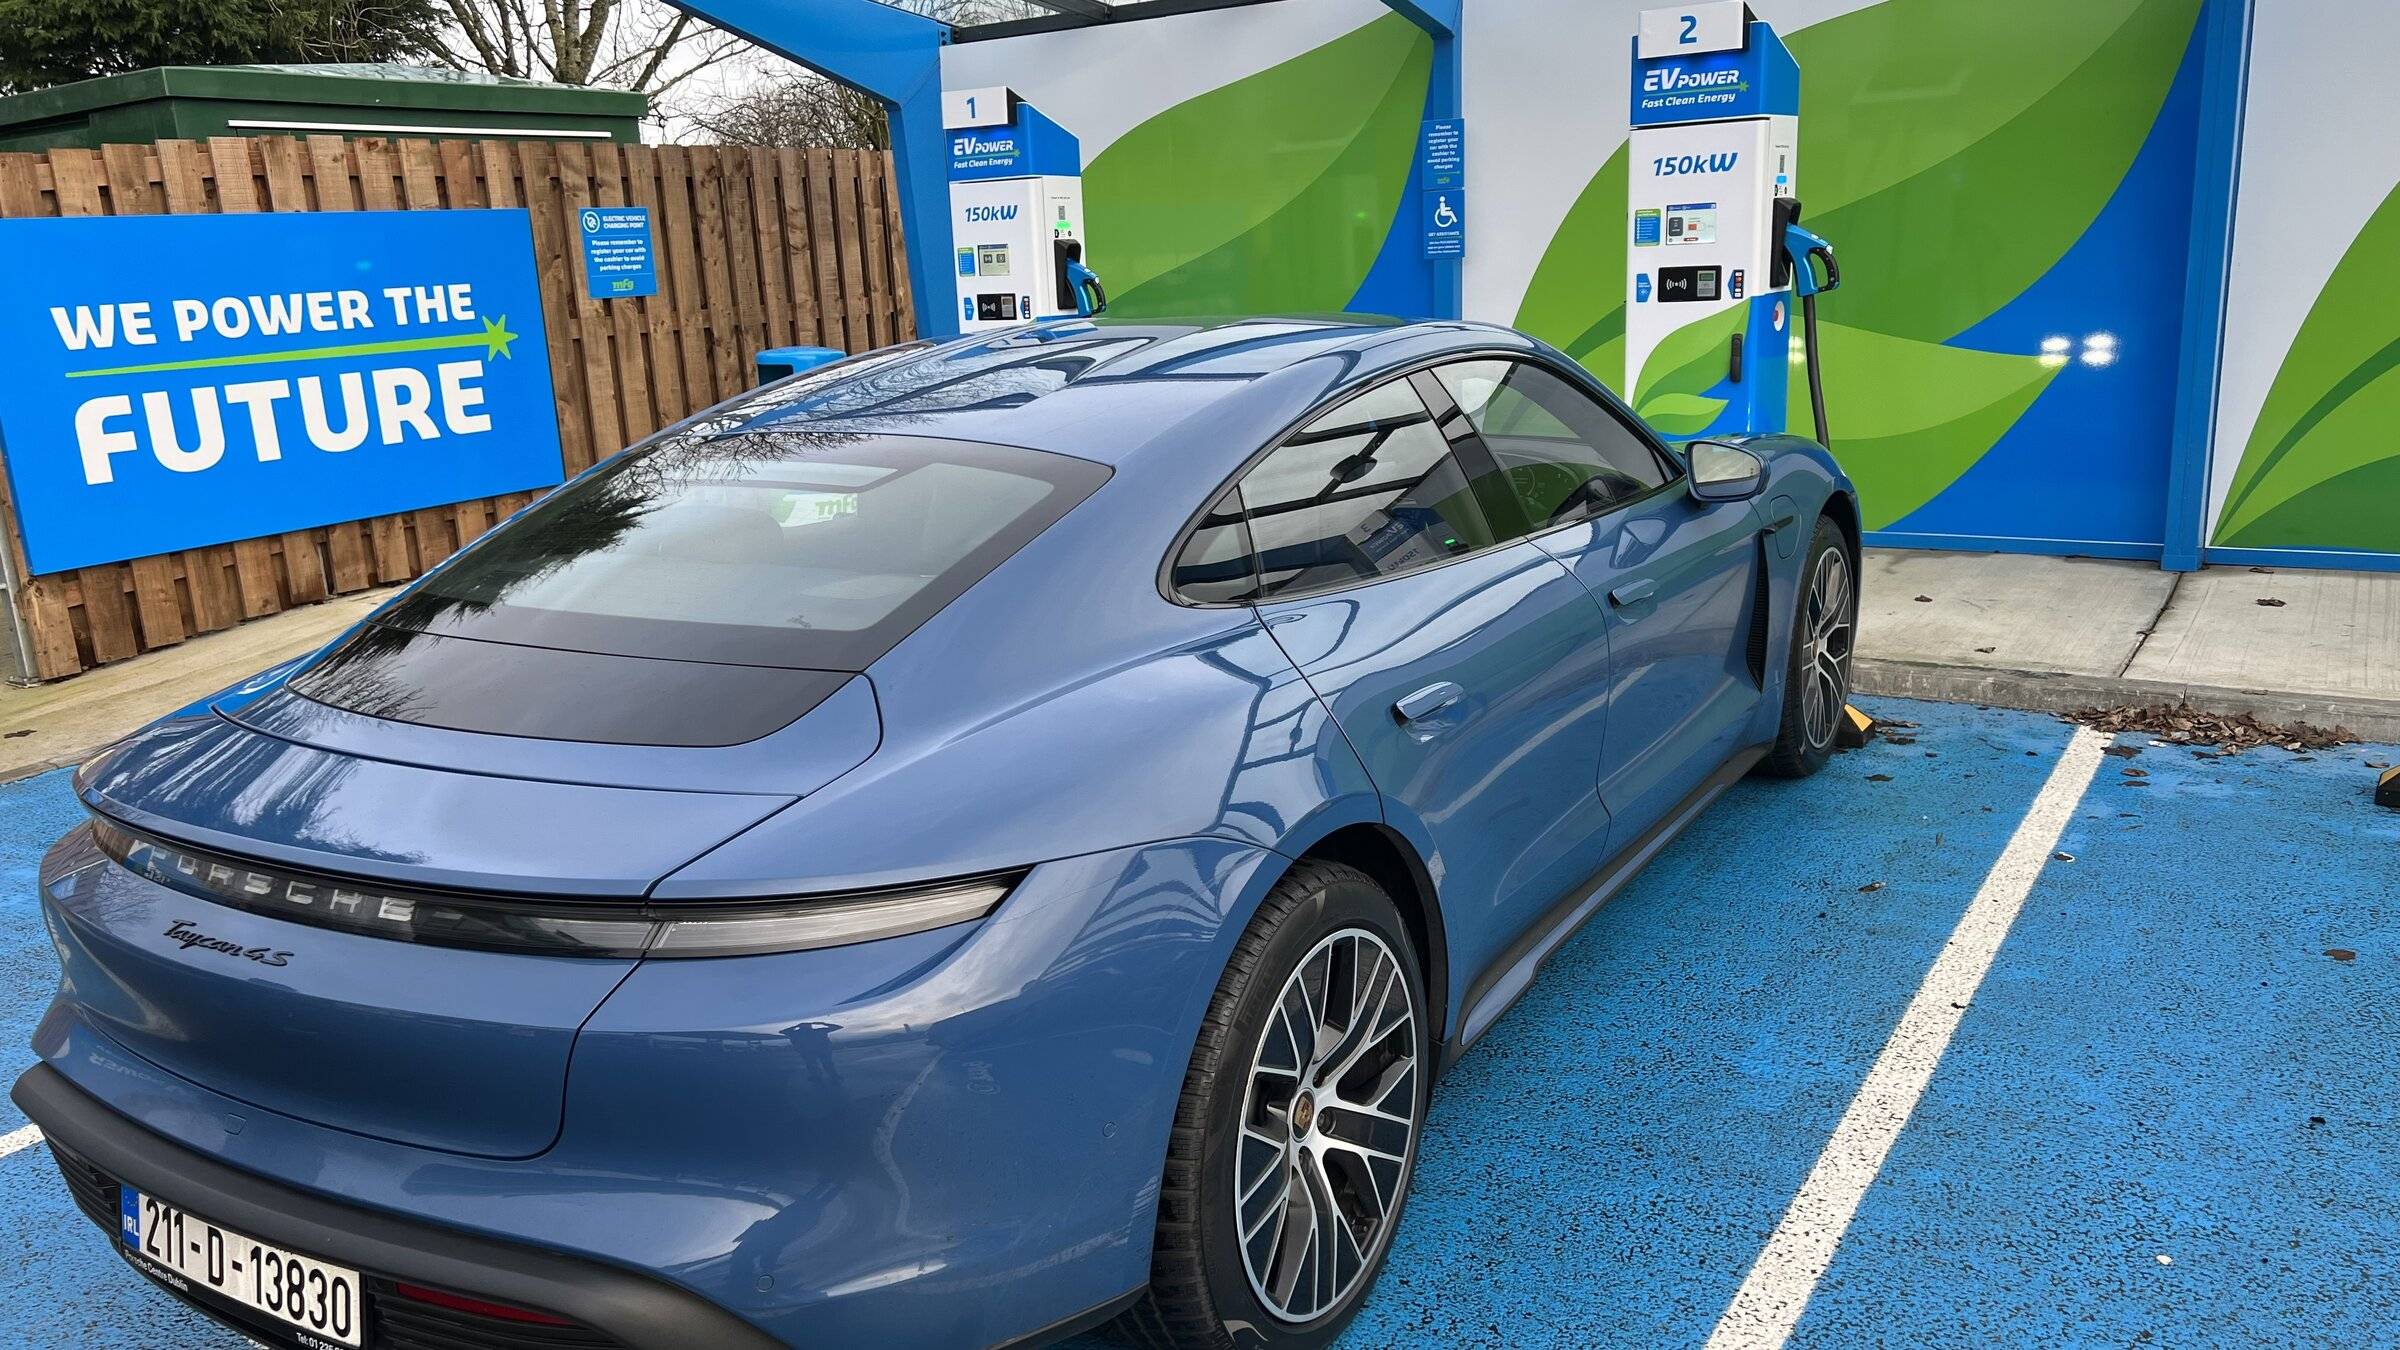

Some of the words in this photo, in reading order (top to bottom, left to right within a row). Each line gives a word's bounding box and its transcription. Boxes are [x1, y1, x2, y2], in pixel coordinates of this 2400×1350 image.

[1679, 16, 1697, 44] 2
[966, 97, 976, 118] 1
[1642, 98, 1663, 108] Fast
[1666, 97, 1695, 106] Clean
[1698, 93, 1736, 103] Energy
[989, 158, 1012, 166] Energy
[1654, 152, 1738, 176] 150kW
[966, 205, 1018, 222] 150kW
[50, 302, 156, 350] WE
[173, 290, 374, 342] POWER
[384, 284, 476, 325] THE
[74, 360, 492, 486] FUTURE
[147, 845, 416, 922] PORSCHE
[163, 919, 243, 956] Taycan
[124, 1214, 140, 1237] IRL
[146, 1199, 351, 1338] 211-D-13830
